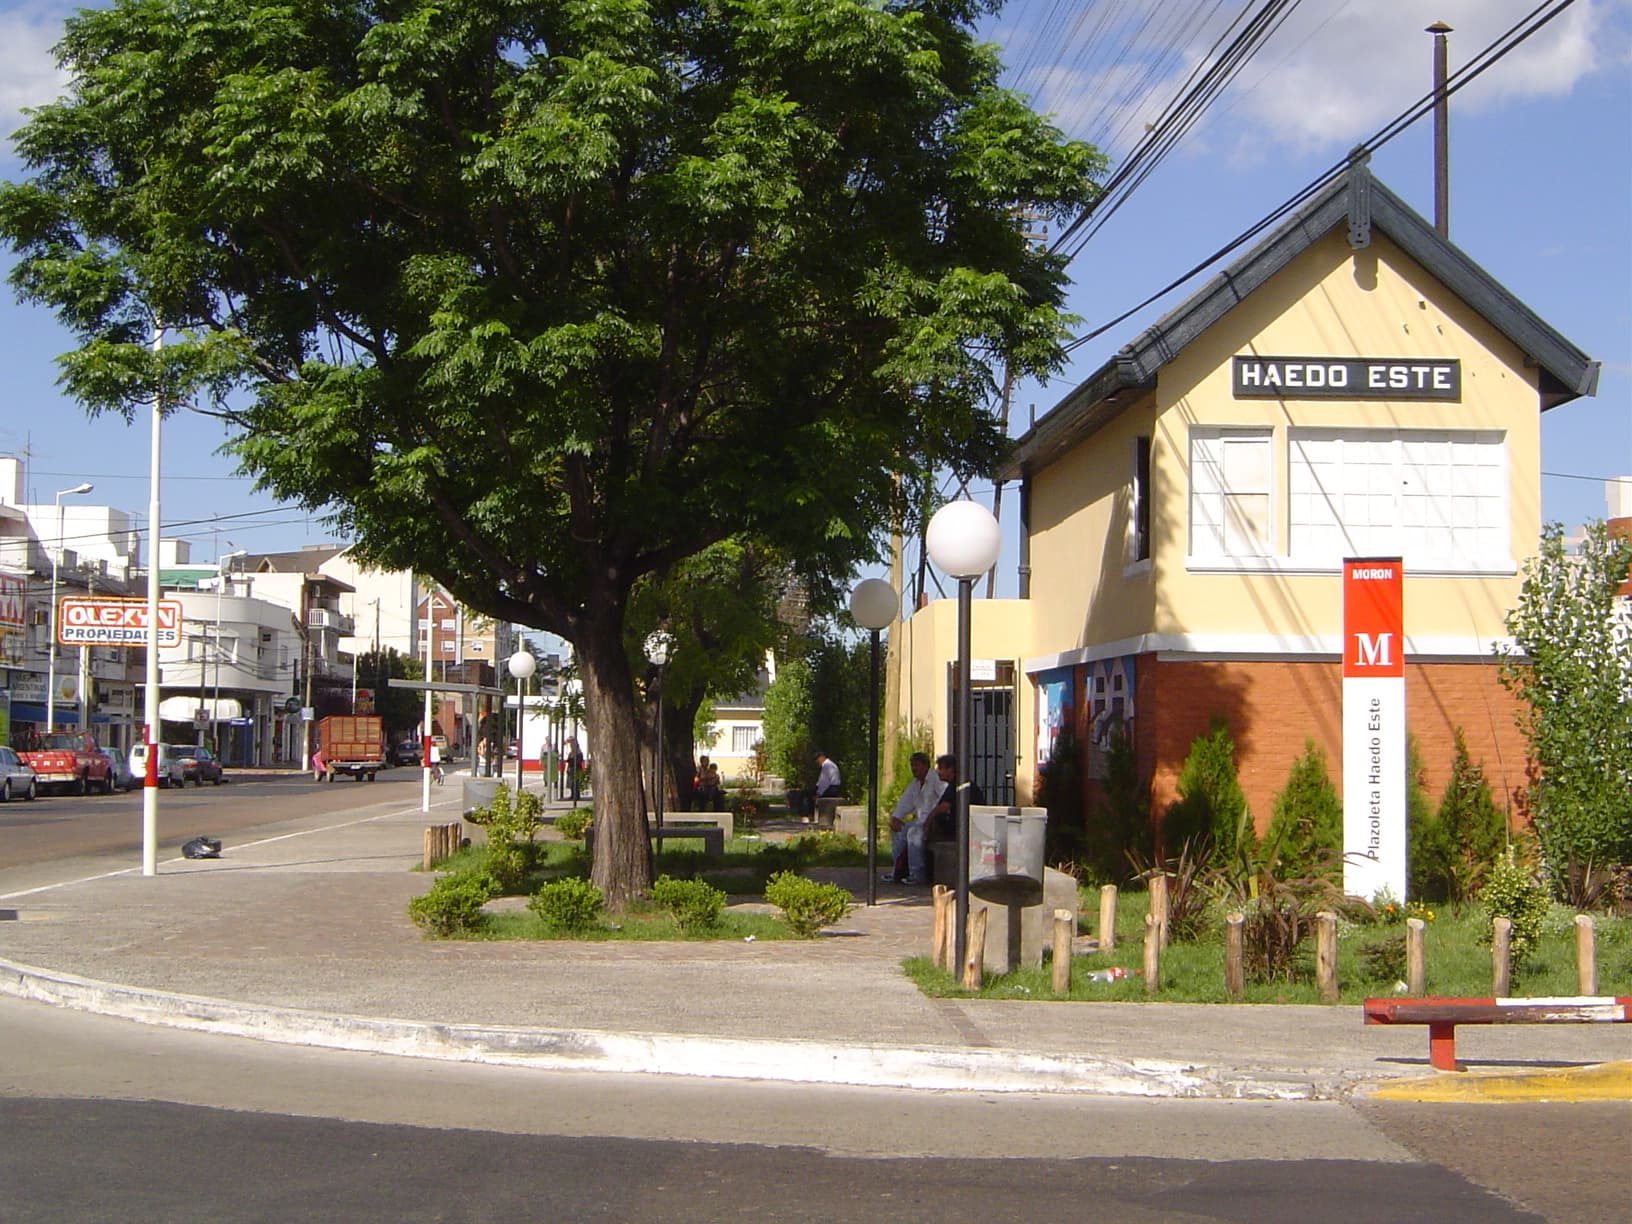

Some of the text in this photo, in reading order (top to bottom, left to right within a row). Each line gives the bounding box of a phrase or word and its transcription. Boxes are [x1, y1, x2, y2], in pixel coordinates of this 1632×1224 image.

[1241, 363, 1452, 389] HAEDO ESTE
[1352, 568, 1393, 580] MORON
[1353, 632, 1393, 666] M
[1367, 697, 1381, 859] Plazoleta Haedo Este
